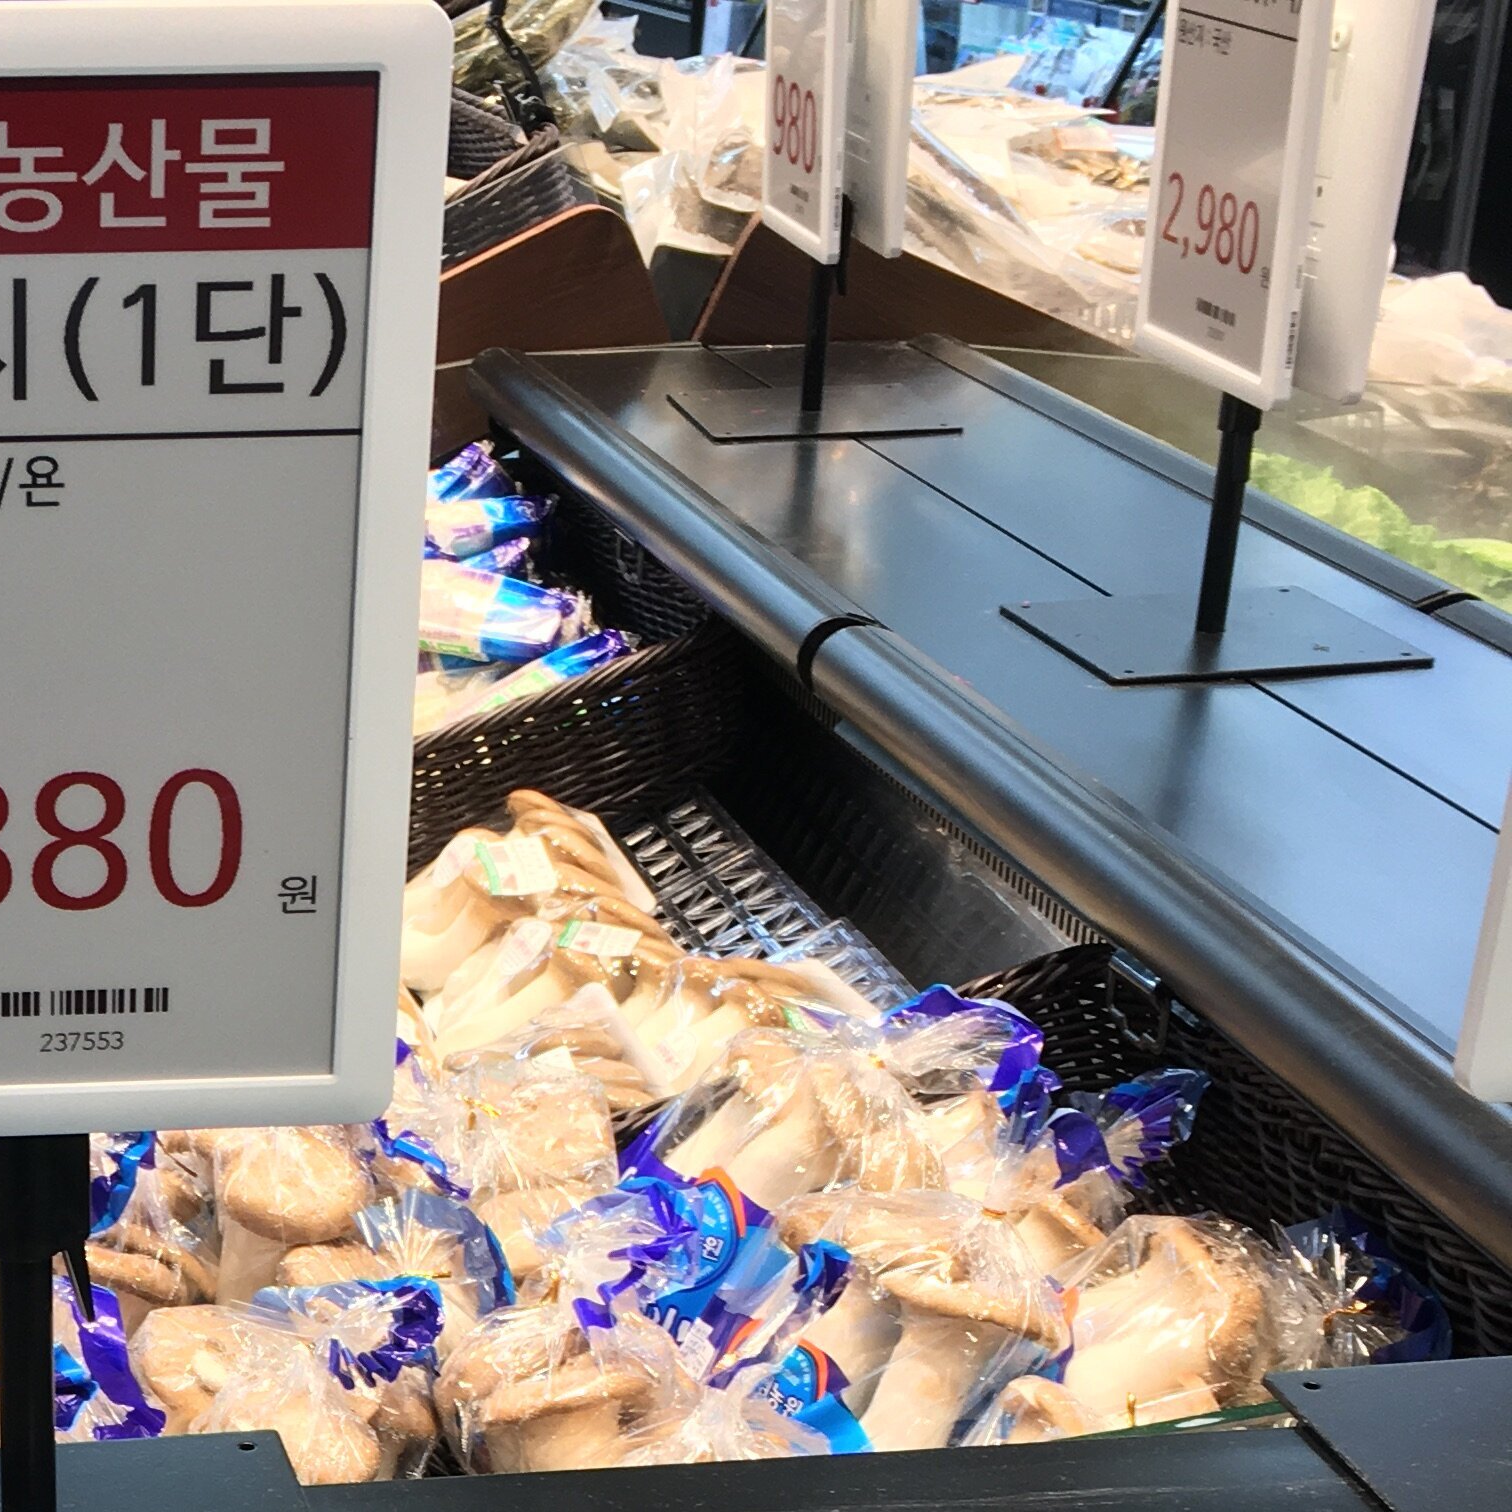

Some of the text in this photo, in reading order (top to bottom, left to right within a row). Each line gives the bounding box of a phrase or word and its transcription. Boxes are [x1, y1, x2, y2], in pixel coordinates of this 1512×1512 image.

[773, 74, 817, 175] 980
[1161, 171, 1260, 276] 2,980
[277, 874, 318, 915] 원
[39, 1030, 125, 1054] 237553
